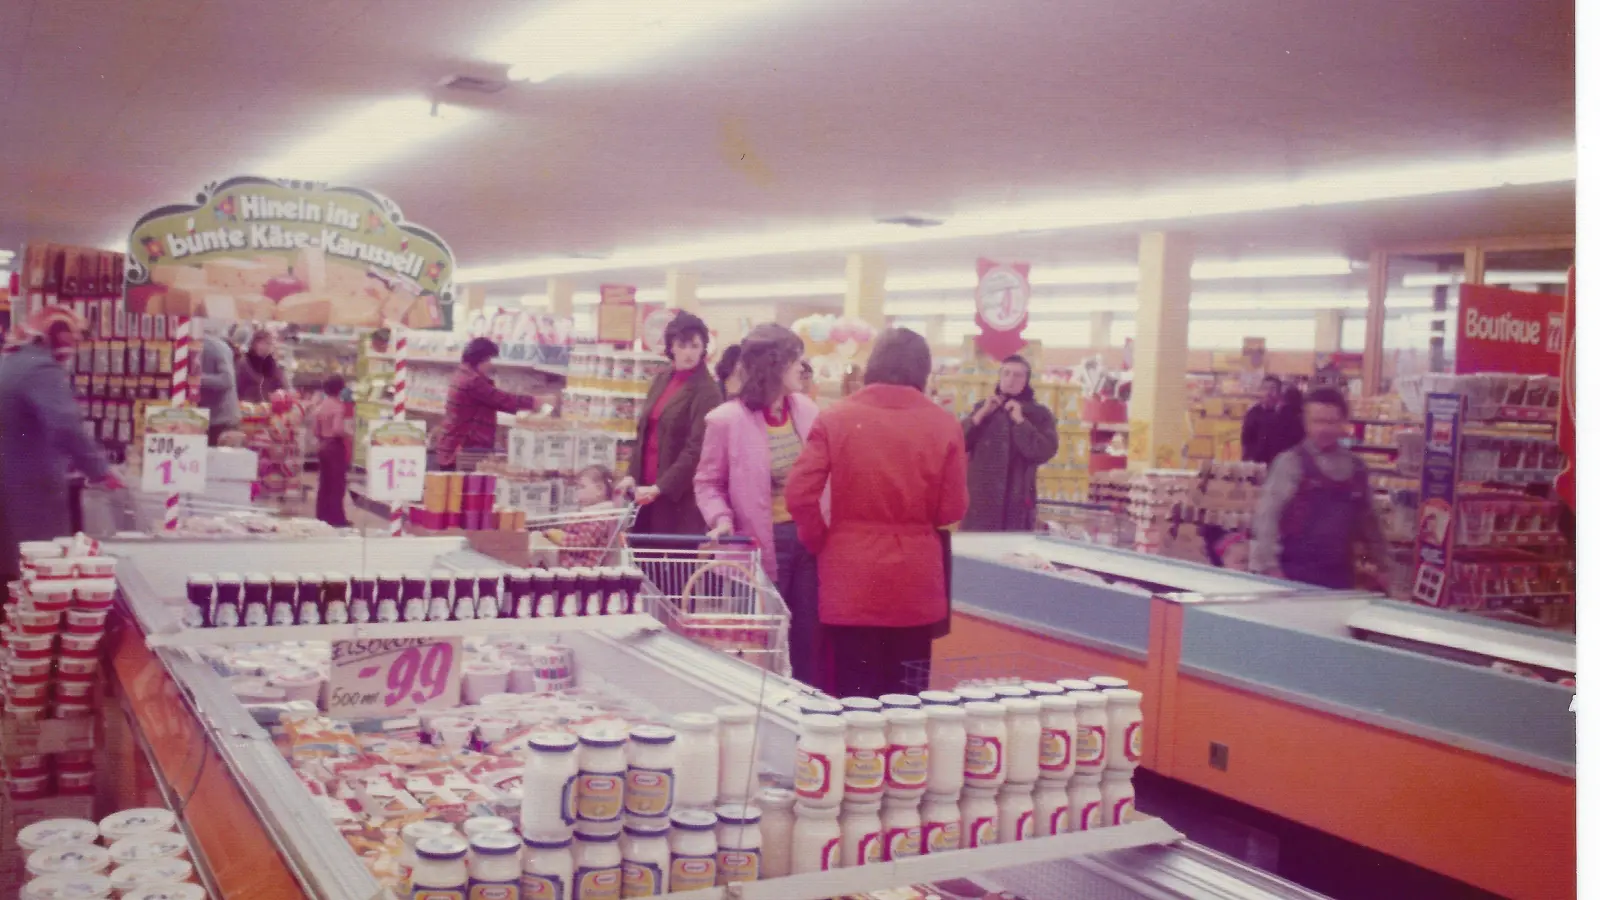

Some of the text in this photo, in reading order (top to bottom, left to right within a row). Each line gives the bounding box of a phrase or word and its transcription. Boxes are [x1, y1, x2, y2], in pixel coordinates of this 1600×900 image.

[240, 193, 361, 229] Hinein ins
[1465, 307, 1541, 345] Boutique
